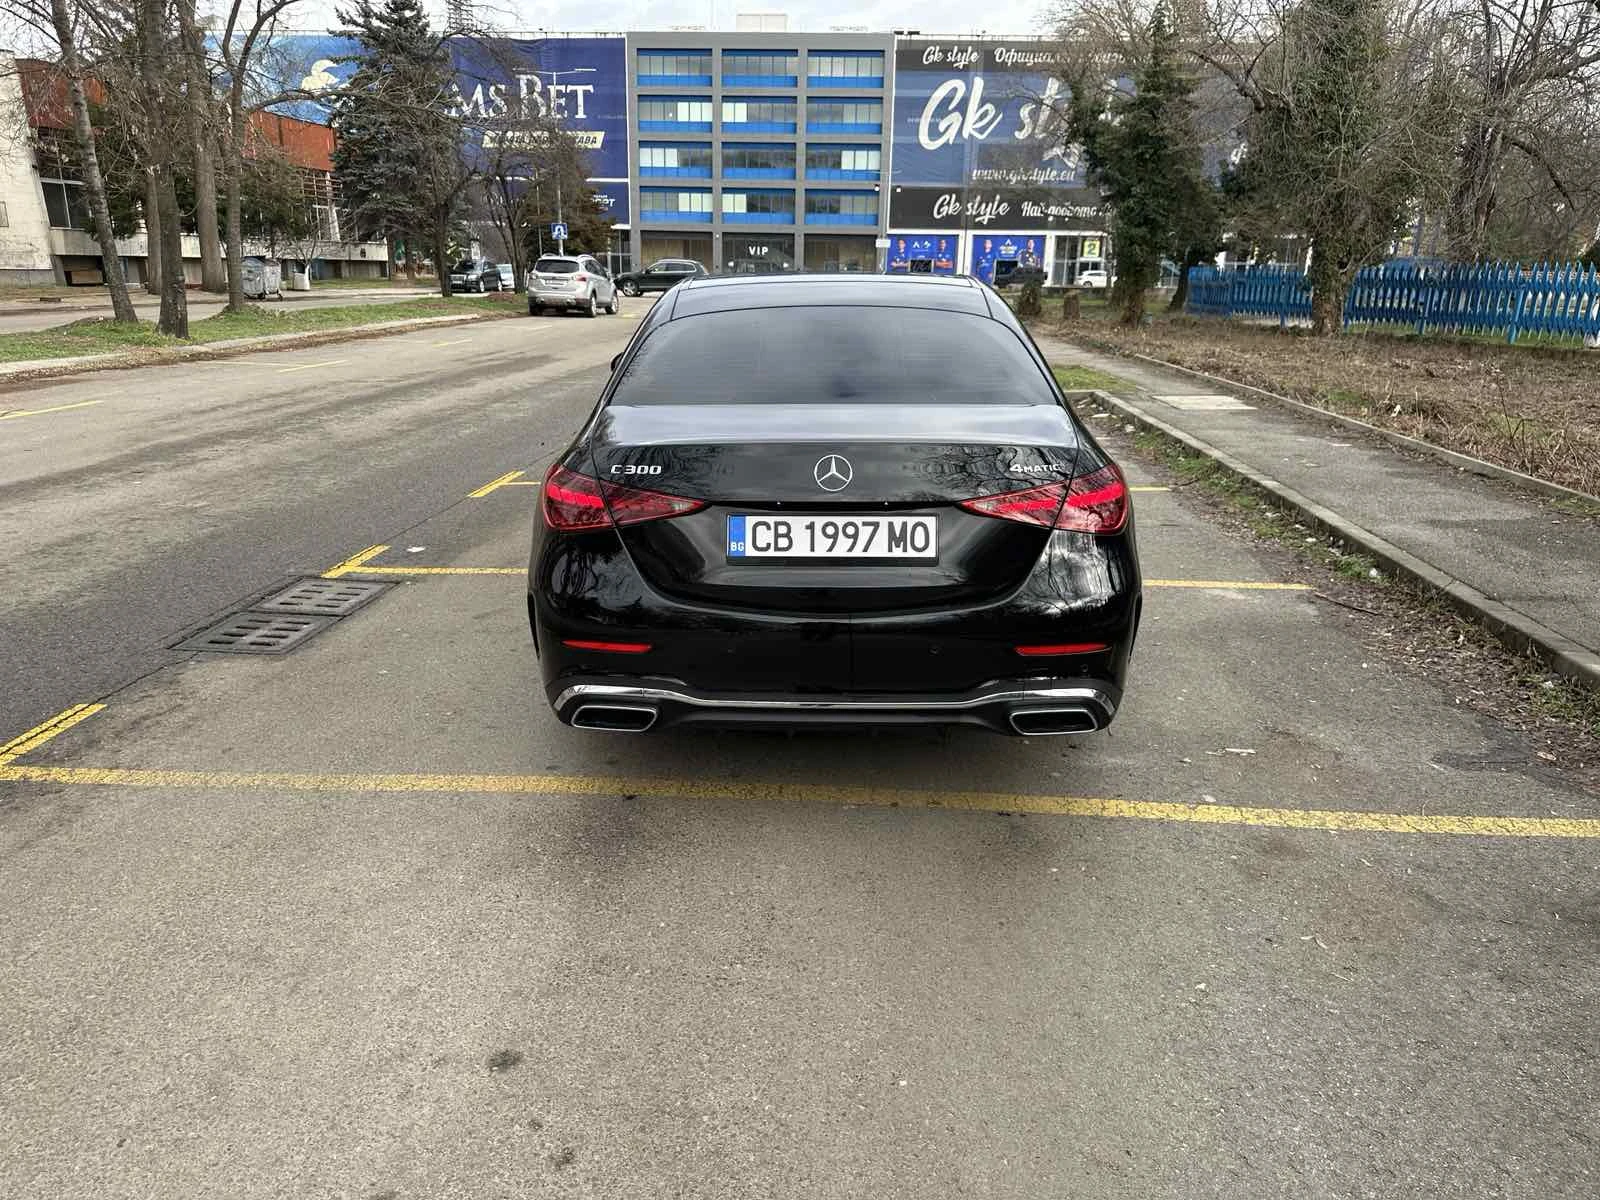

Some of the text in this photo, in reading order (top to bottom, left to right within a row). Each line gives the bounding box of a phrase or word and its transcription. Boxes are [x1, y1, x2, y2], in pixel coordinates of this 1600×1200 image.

[922, 46, 980, 69] Gk style
[918, 76, 1003, 150] Gk
[933, 194, 1010, 225] Gk style
[748, 246, 769, 256] VIP
[1087, 243, 1097, 255] 2
[1010, 463, 1062, 473] 4MATIC
[752, 520, 930, 553] CB 1997 MO
[730, 542, 744, 551] BG
